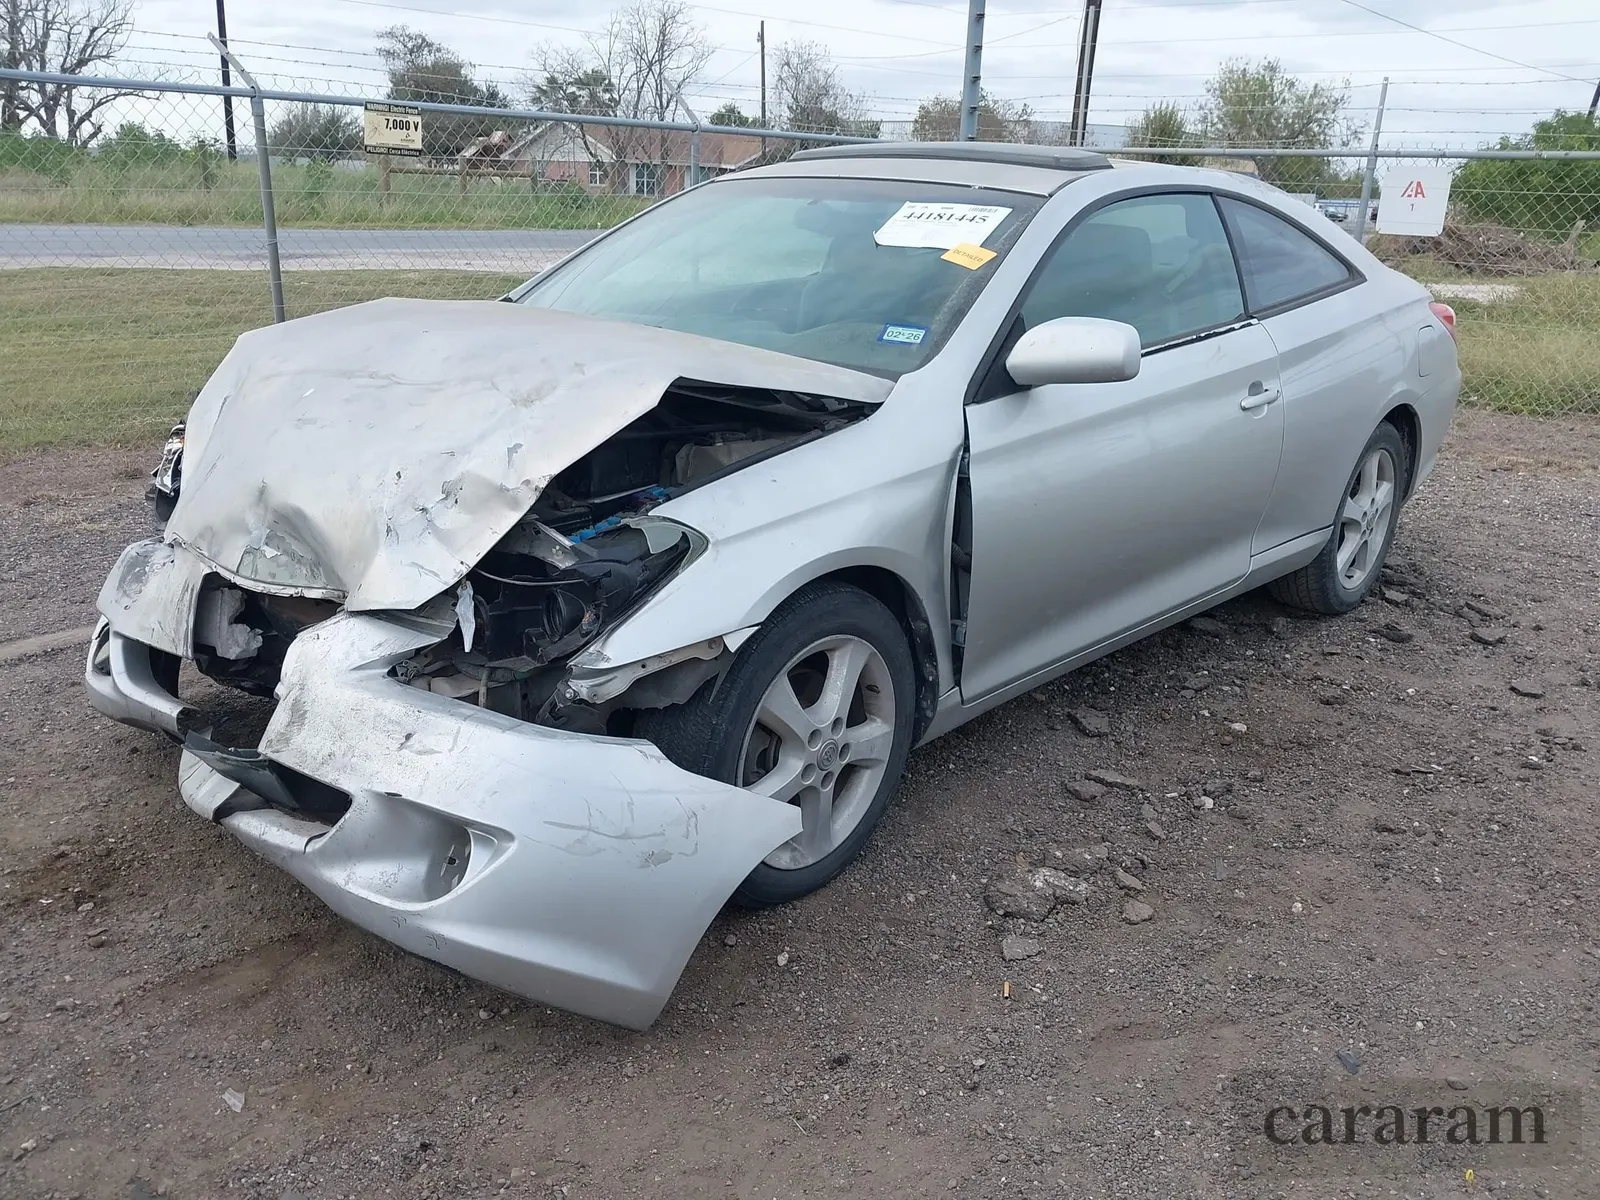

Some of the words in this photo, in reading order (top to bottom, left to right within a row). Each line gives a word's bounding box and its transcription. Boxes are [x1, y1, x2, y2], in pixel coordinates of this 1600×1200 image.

[385, 118, 411, 131] 7,000
[413, 121, 419, 132] V
[903, 212, 990, 224] 44181445
[953, 249, 984, 263] DETAILED
